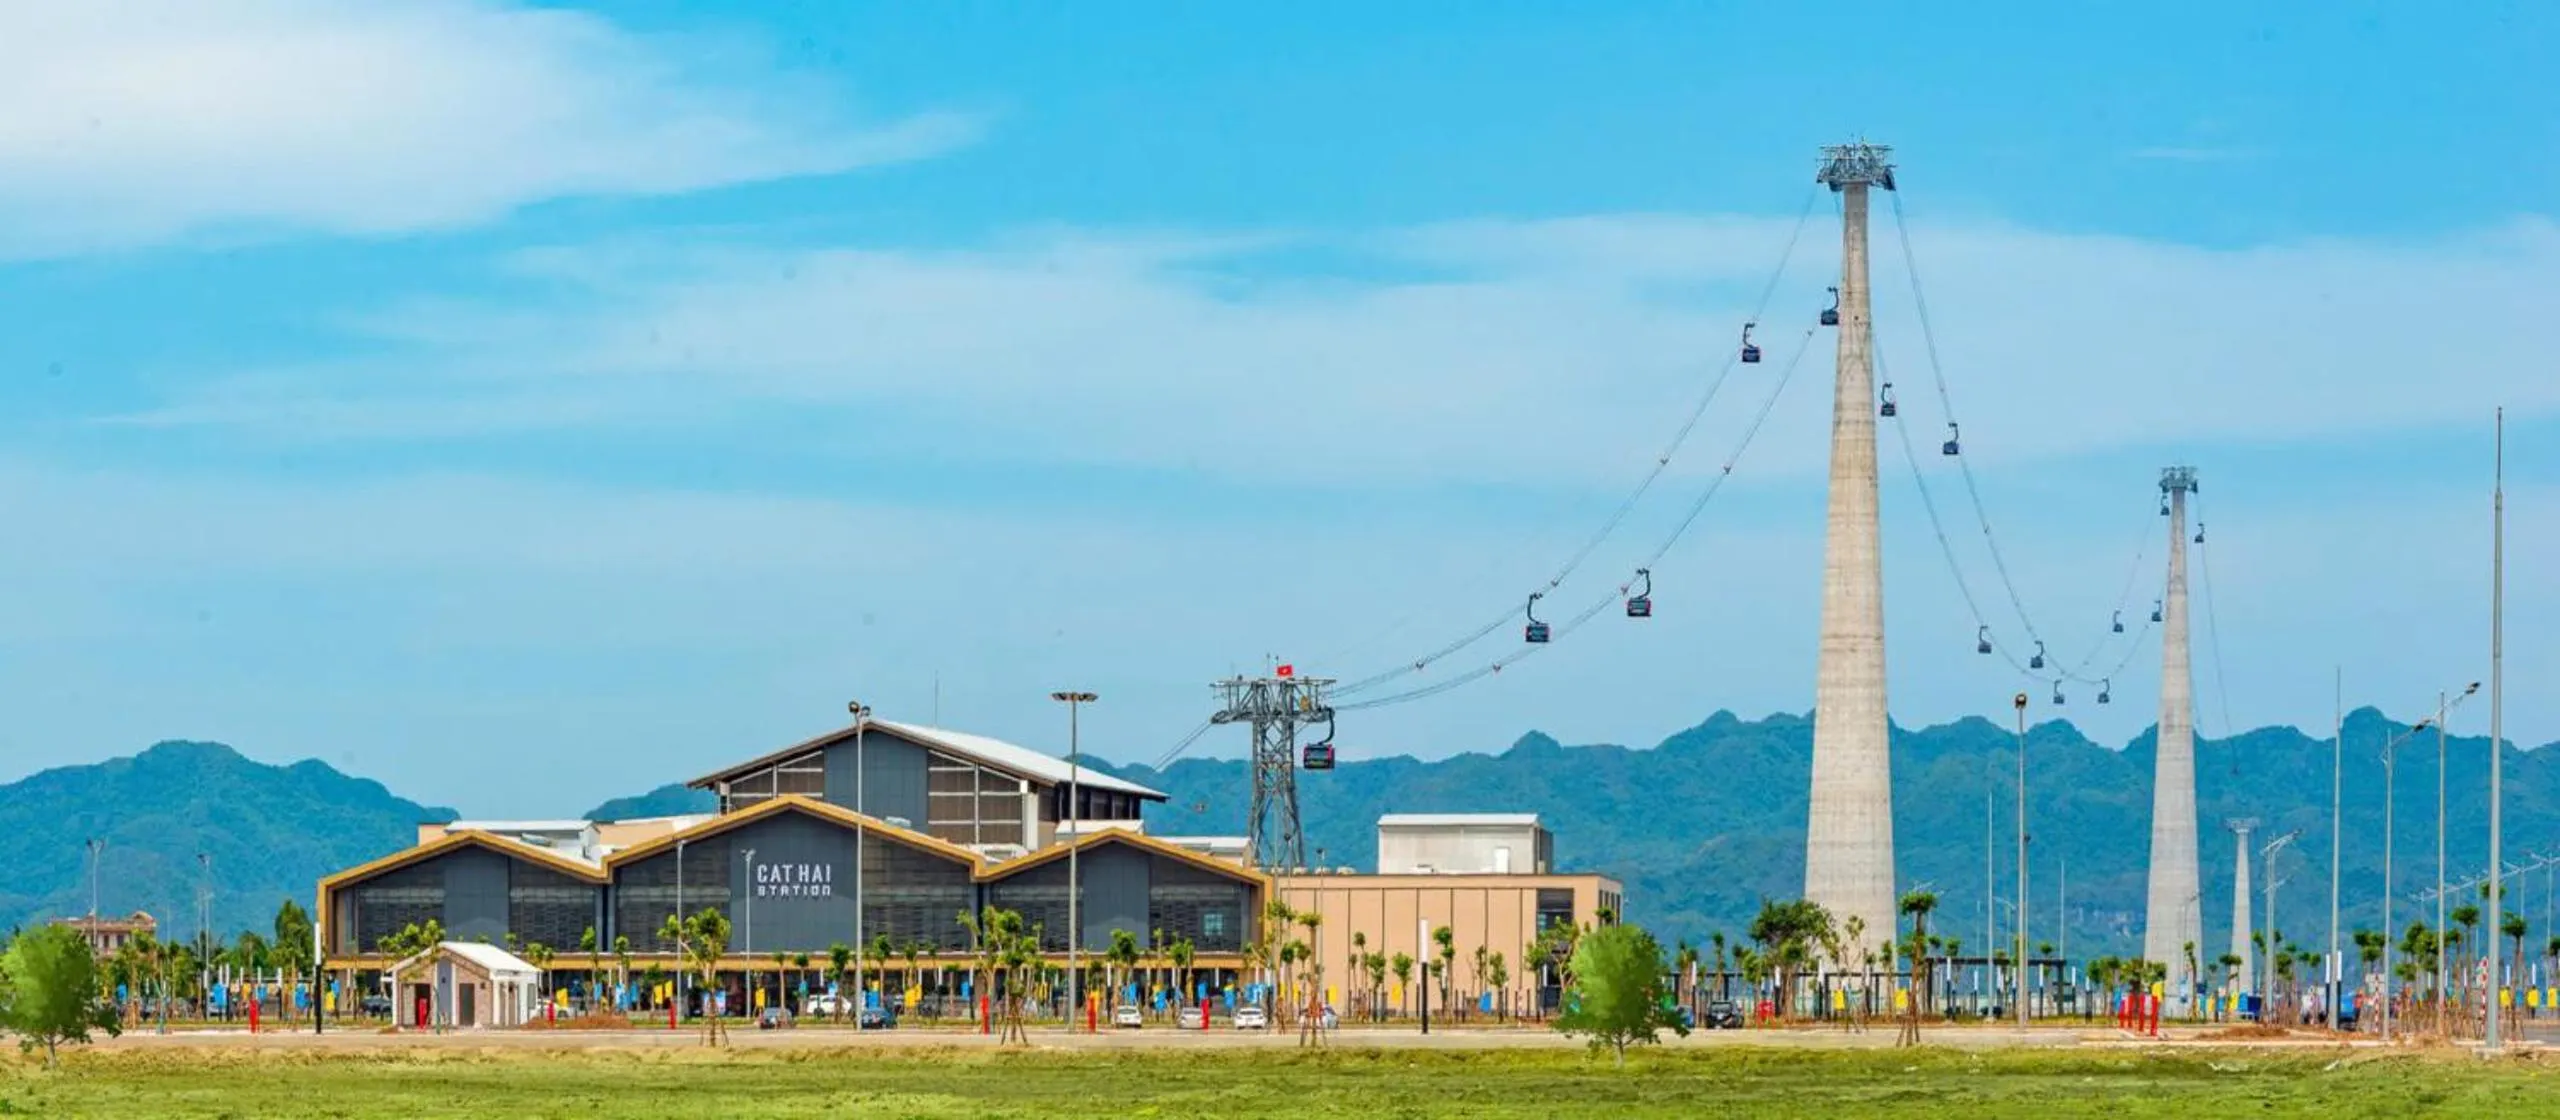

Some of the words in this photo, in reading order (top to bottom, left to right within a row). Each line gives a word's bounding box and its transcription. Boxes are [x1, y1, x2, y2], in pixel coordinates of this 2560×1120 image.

[757, 864, 792, 883] CAT
[798, 864, 831, 883] HAI
[757, 885, 831, 896] STATION
